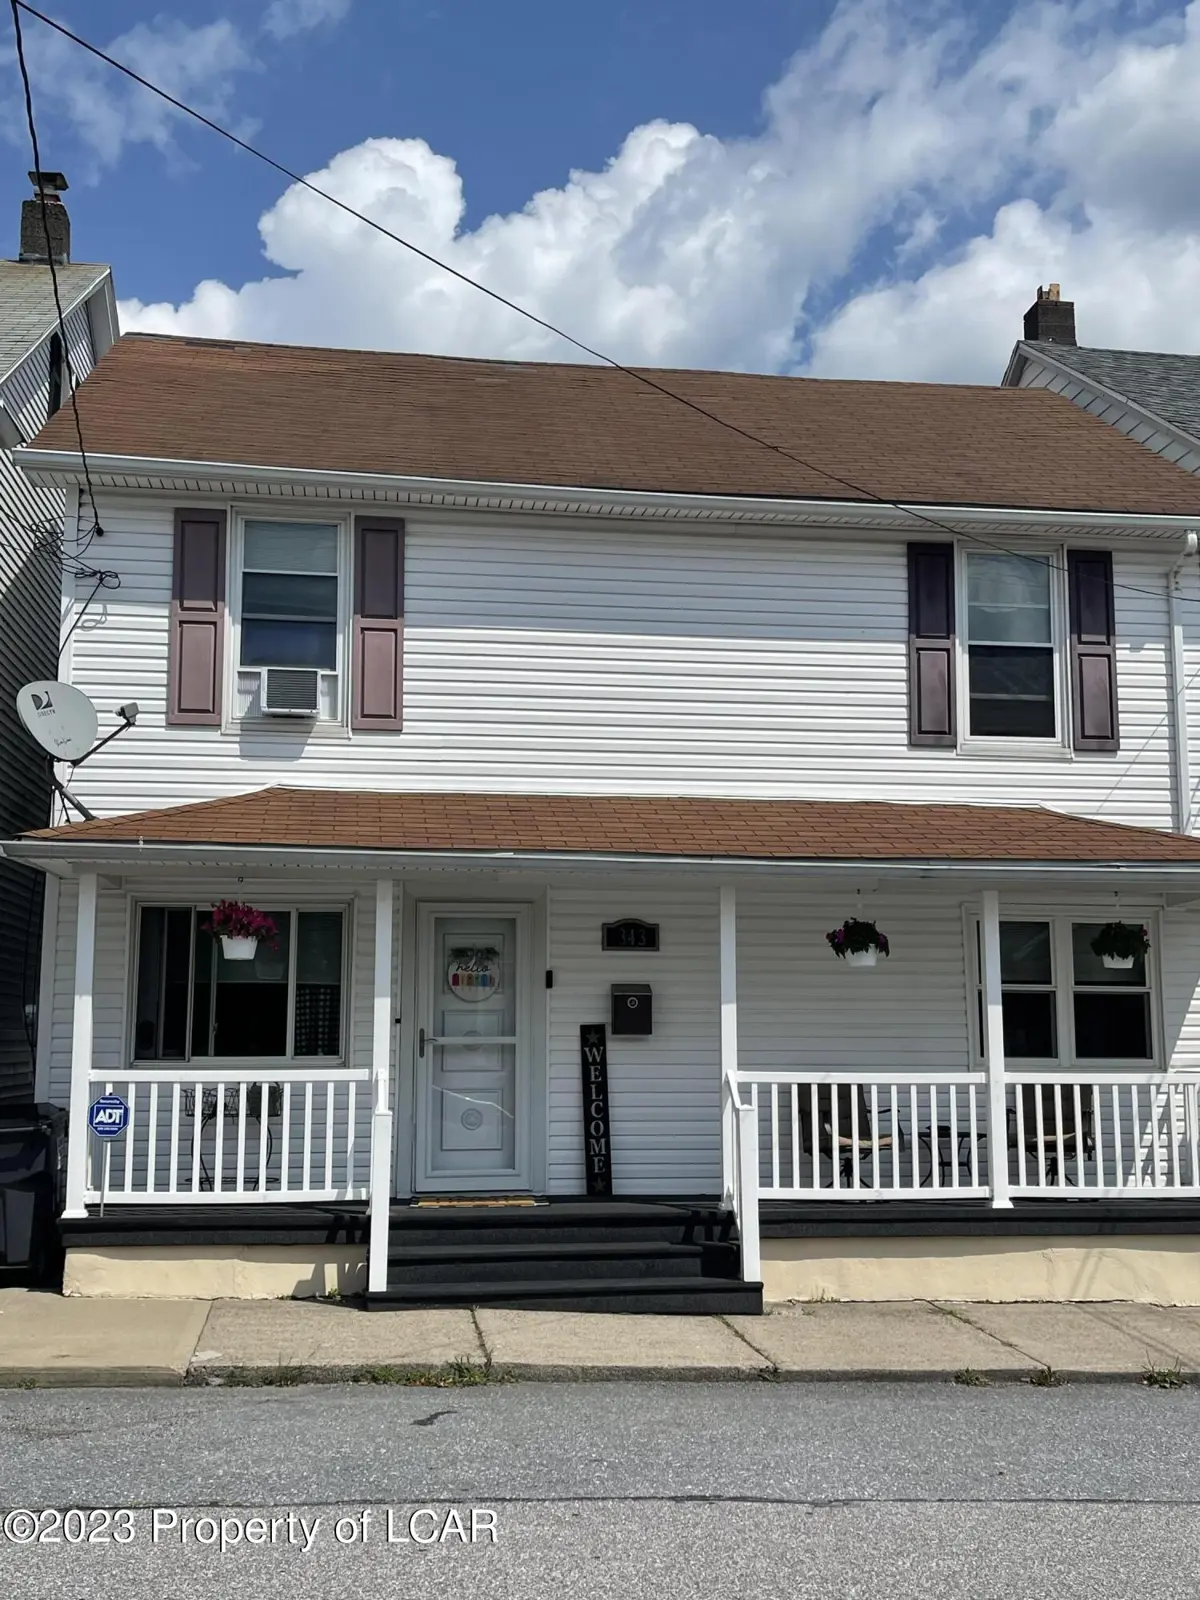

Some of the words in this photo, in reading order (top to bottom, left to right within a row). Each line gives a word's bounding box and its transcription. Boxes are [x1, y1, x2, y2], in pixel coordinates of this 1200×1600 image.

[619, 928, 646, 946] 343
[95, 1108, 123, 1123] ADT
[584, 1046, 607, 1173] WELCOME
